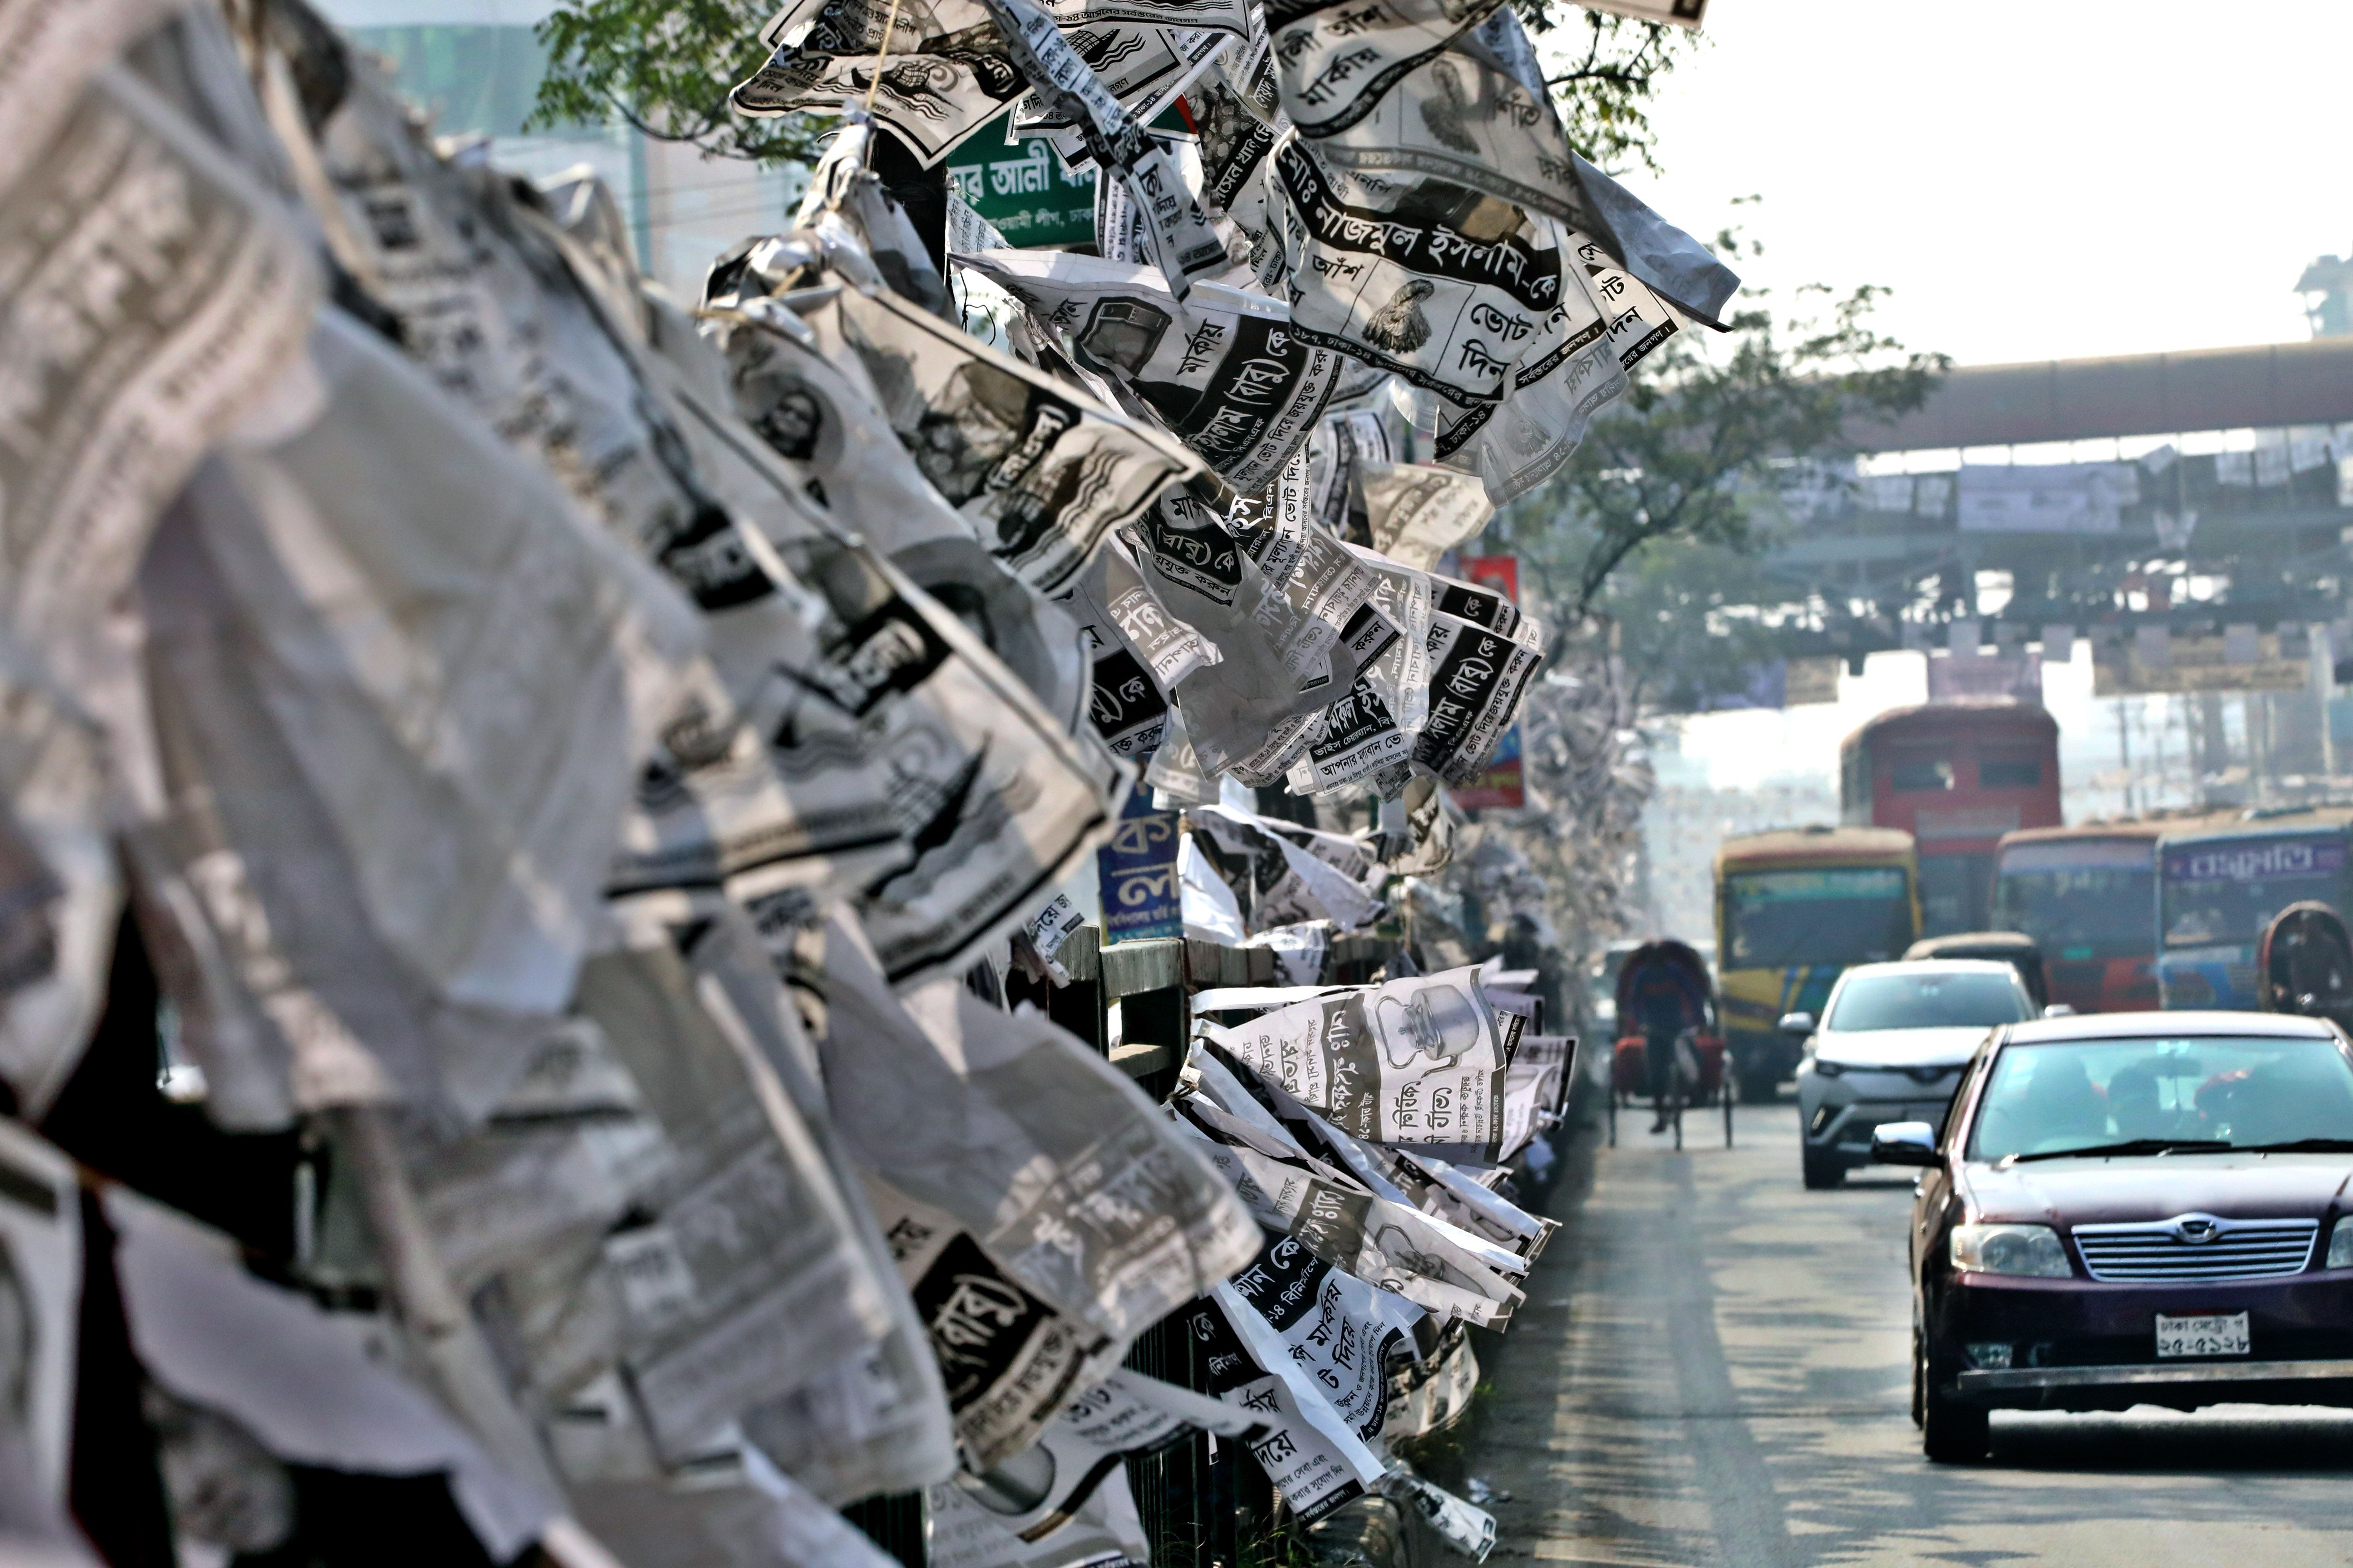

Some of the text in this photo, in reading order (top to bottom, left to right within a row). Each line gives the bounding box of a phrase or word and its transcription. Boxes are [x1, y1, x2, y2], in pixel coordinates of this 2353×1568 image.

[1081, 9, 1120, 20] আসনের
[1122, 10, 1163, 20] সর্বস্তরের
[1108, 77, 1129, 92] নগণ
[1316, 196, 1421, 256] নাজমুল
[1428, 224, 1557, 300] ইসলাম-কে
[1312, 254, 1364, 281] আঁশ
[1470, 303, 1533, 342] ভোট
[1176, 317, 1226, 375] মার্কায়
[1327, 337, 1371, 361] ঢাকা-১৪
[1637, 330, 1663, 351] জনগণ
[1223, 357, 1290, 406] (বাবু)
[1265, 327, 1290, 356] কে
[1458, 338, 1510, 379] দিন
[1519, 332, 1592, 385] সর্বস্তরের জনগণ
[1257, 442, 1277, 462] ভোট
[1268, 418, 1294, 442] দিয়ে
[1292, 380, 1316, 418] জয়যুক্ত
[1308, 349, 1328, 377] করু
[1449, 410, 1485, 445] ঢাকা-১৪
[1304, 468, 1313, 485] জনগণ
[1261, 483, 1275, 520] বিএন
[1282, 486, 1297, 522] ভোট
[1301, 487, 1312, 510] সর্বস্তরের
[1301, 510, 1310, 531] আসনের
[1153, 554, 1231, 597] য়যুক্ত করুন
[1214, 550, 1240, 572] কে
[1464, 596, 1482, 617] কে
[1354, 622, 1382, 651] করুন
[1119, 676, 1145, 703] কে
[1425, 699, 1465, 739] সলাম
[1445, 657, 1494, 700] (বাবু)
[1477, 637, 1497, 657] কে
[1465, 649, 1529, 755] ভোট দিয়ে জয়যুক্ত করুন
[1290, 745, 1307, 760] আসনের
[1316, 724, 1329, 739] জনগণ
[1313, 725, 1377, 757] ভাইস চেয়ারম্যান,
[1320, 733, 1402, 776] আপনার মূল্যবান ভো
[1384, 752, 1401, 762] আসনের
[1270, 1235, 1300, 1270] কে
[1280, 1254, 1318, 1305] বিনির্মাণে
[1194, 1312, 1214, 1342] কে
[1306, 1278, 1344, 1347] মার্কায়
[1362, 1321, 1372, 1337] এবং
[1332, 1316, 1356, 1371] দিয়ে
[1354, 1391, 1373, 1416] উন্নয়নে
[1373, 1321, 1386, 1336] দিন
[1371, 1404, 1383, 1427] ঢাকা-১৪
[1290, 1465, 1344, 1501] করার সুযোগ দিন
[1294, 1454, 1328, 1479] সেবা এবং
